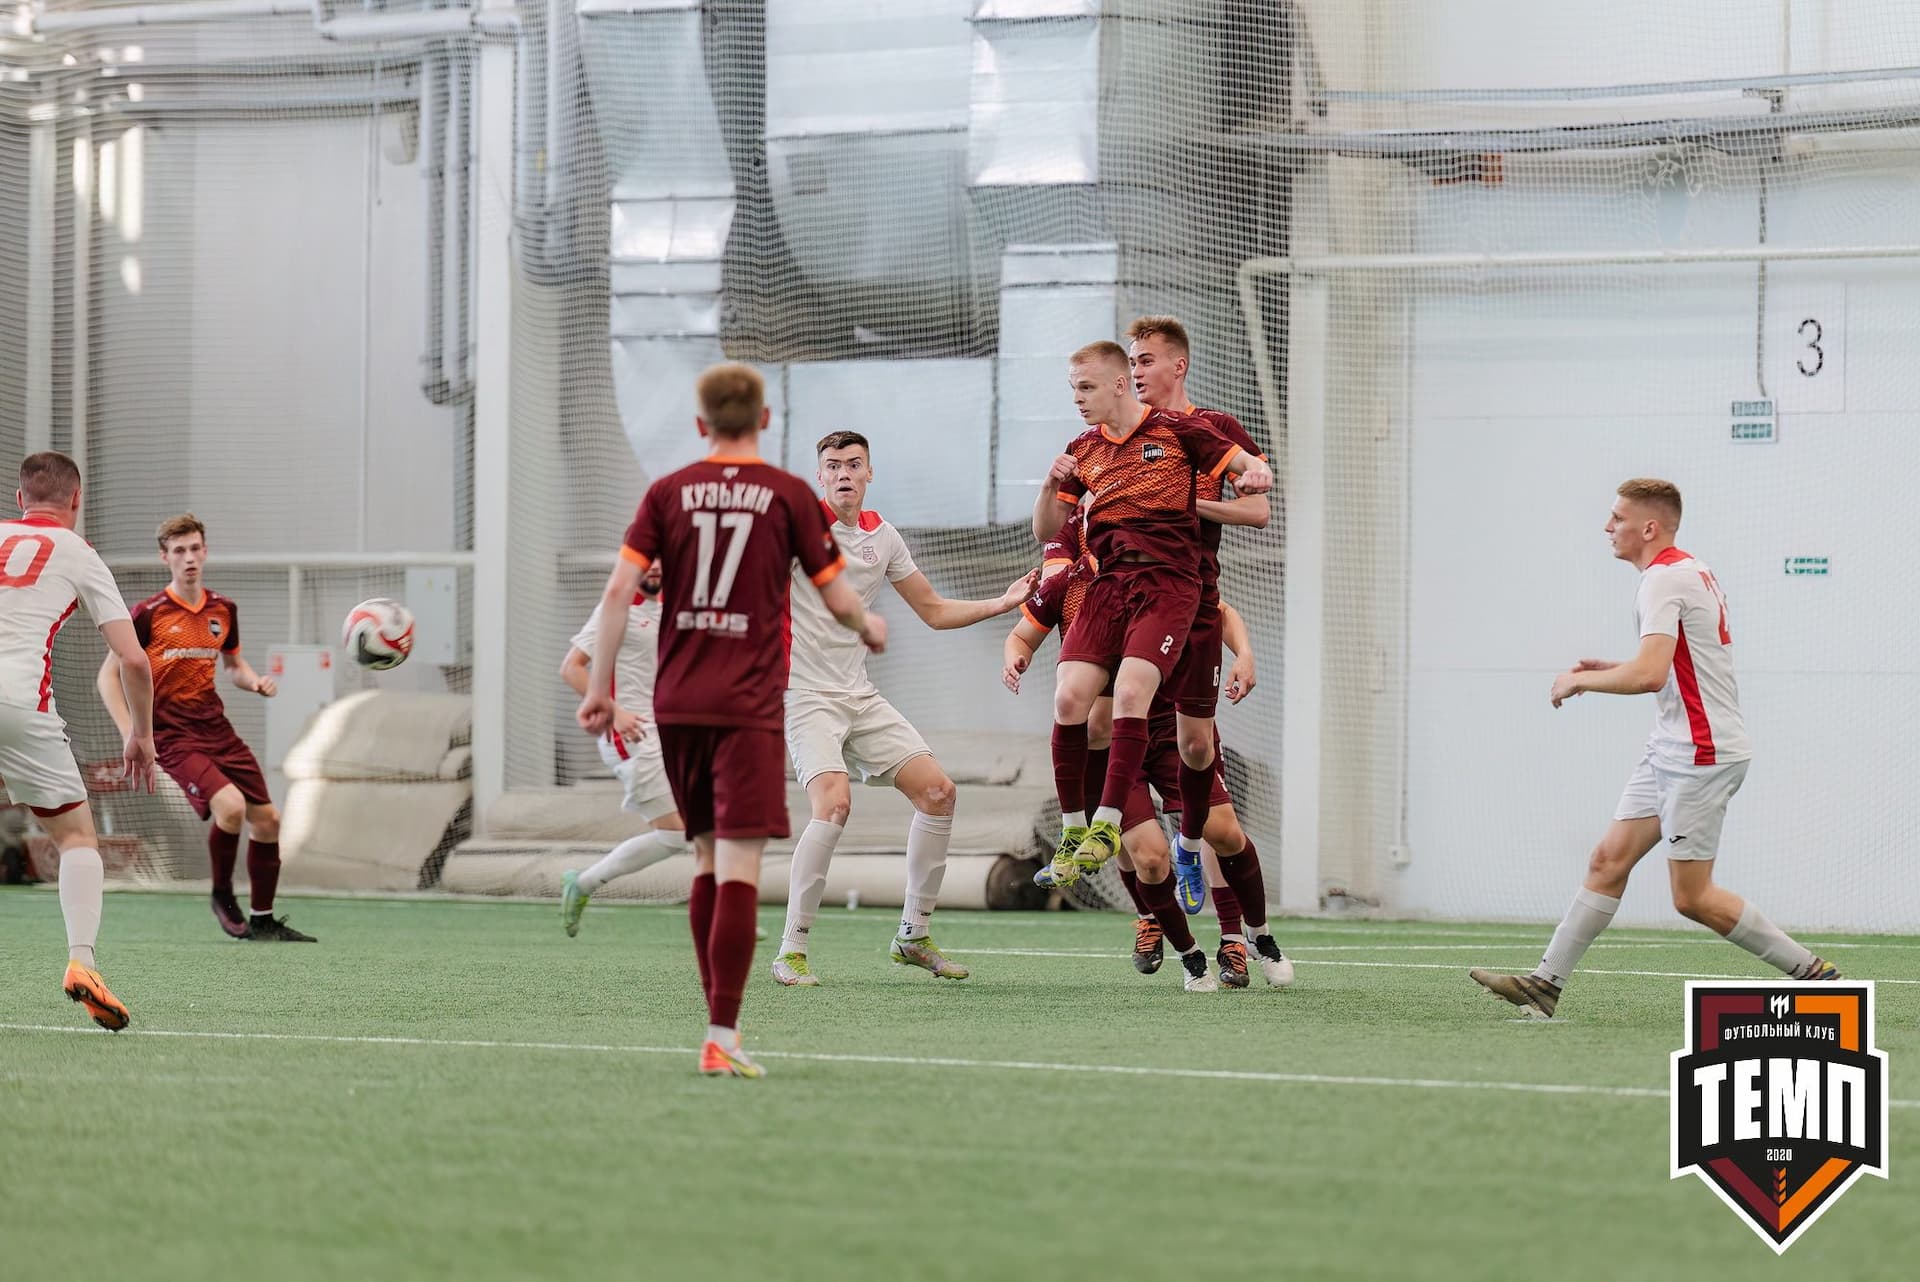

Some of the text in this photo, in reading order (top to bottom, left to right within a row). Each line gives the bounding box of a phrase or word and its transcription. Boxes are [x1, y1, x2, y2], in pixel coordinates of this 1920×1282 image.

[1796, 318, 1824, 377] 3
[681, 482, 774, 515] КУЗЬКИН
[692, 511, 754, 609] 17
[1159, 634, 1174, 656] 2
[1213, 666, 1220, 687] 6
